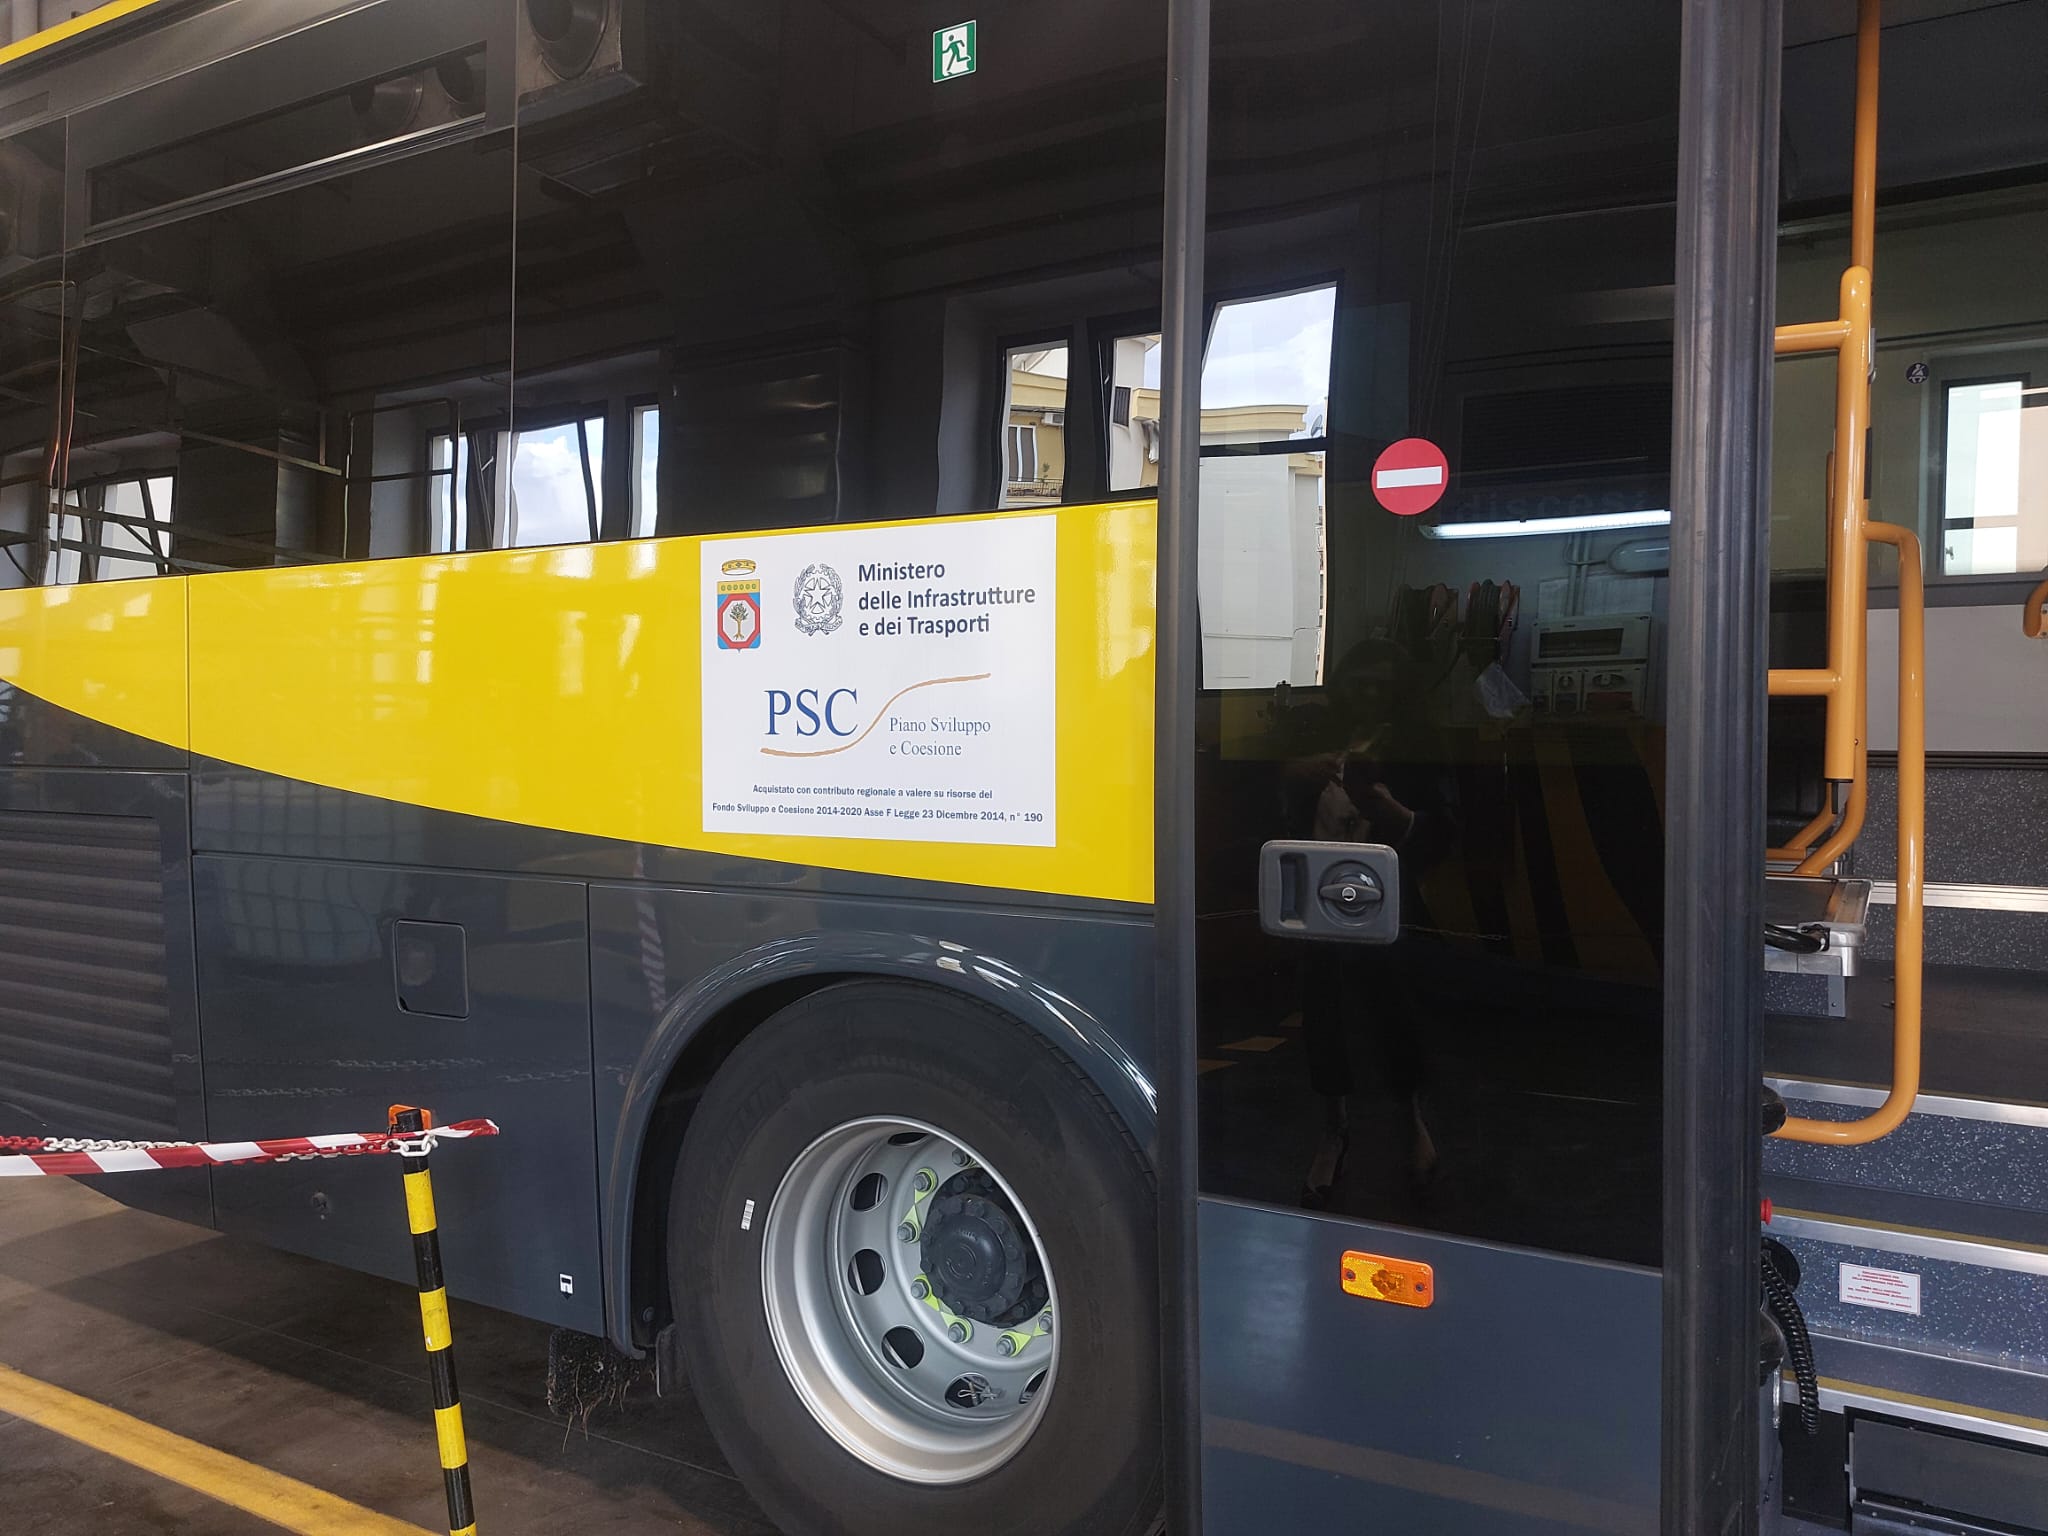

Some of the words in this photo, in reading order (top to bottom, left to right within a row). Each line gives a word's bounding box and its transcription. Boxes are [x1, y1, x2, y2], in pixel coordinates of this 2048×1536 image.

[859, 561, 945, 583] Ministero
[859, 590, 901, 610] delle
[908, 587, 1035, 608] Infrastrutture
[859, 623, 869, 636] e
[875, 616, 901, 635] dei
[907, 613, 989, 638] Trasporti
[764, 688, 858, 737] PSC
[890, 717, 926, 732] Piano
[931, 717, 991, 736] Sviluppo
[889, 743, 897, 756] e
[901, 741, 961, 755] Coesione
[752, 784, 795, 795] Acquistato
[796, 786, 812, 795] con
[812, 785, 855, 796] contributo
[856, 786, 897, 798] regionale
[897, 789, 904, 797] a
[905, 787, 932, 798] valere
[933, 790, 945, 798] su
[946, 788, 977, 799] risorse
[712, 801, 736, 812] Fondo
[736, 802, 770, 815] Sviluppo
[770, 806, 777, 814] e
[777, 804, 815, 815] Coesione
[816, 805, 863, 817] 2014-2020
[863, 807, 885, 817] Asse
[886, 808, 893, 817] F
[893, 808, 920, 820] Legge
[921, 808, 935, 819] 23
[935, 808, 979, 821] Dicembre
[979, 810, 1008, 823] 2014,
[1023, 812, 1044, 823] 190
